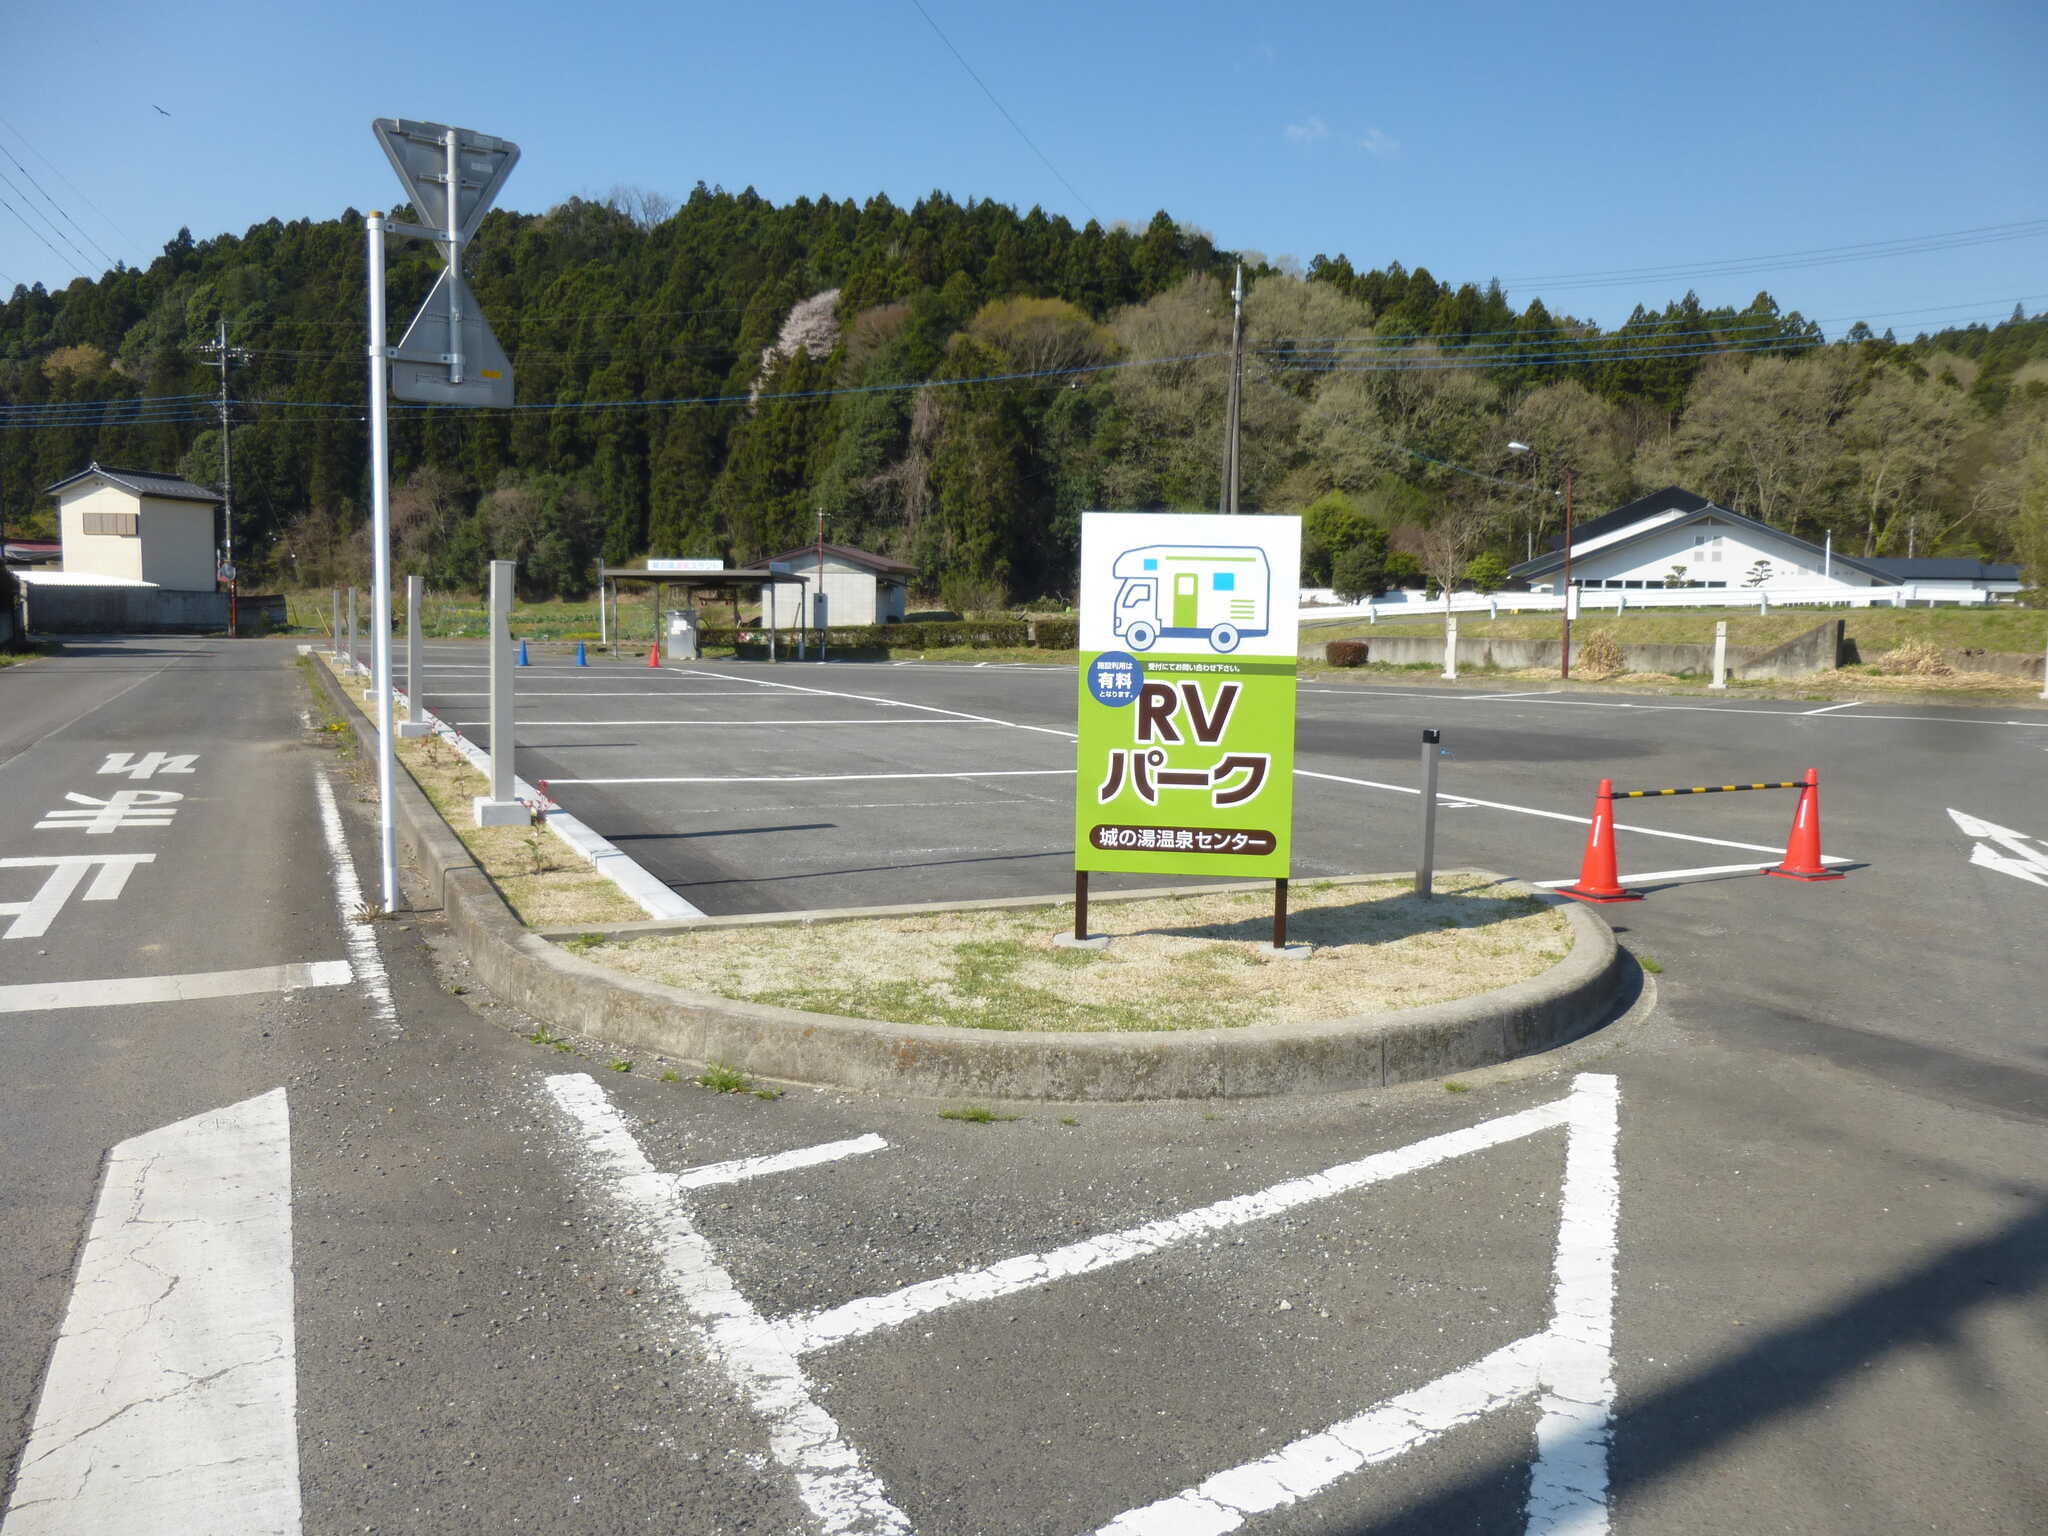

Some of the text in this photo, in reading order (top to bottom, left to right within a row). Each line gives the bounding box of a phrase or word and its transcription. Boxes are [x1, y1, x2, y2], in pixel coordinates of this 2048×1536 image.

[1098, 672, 1132, 689] 有料
[1099, 690, 1133, 699] となります。
[1137, 682, 1240, 743] RV
[1100, 749, 1268, 806] パーク
[1099, 827, 1267, 851] 城の湯温泉センター
